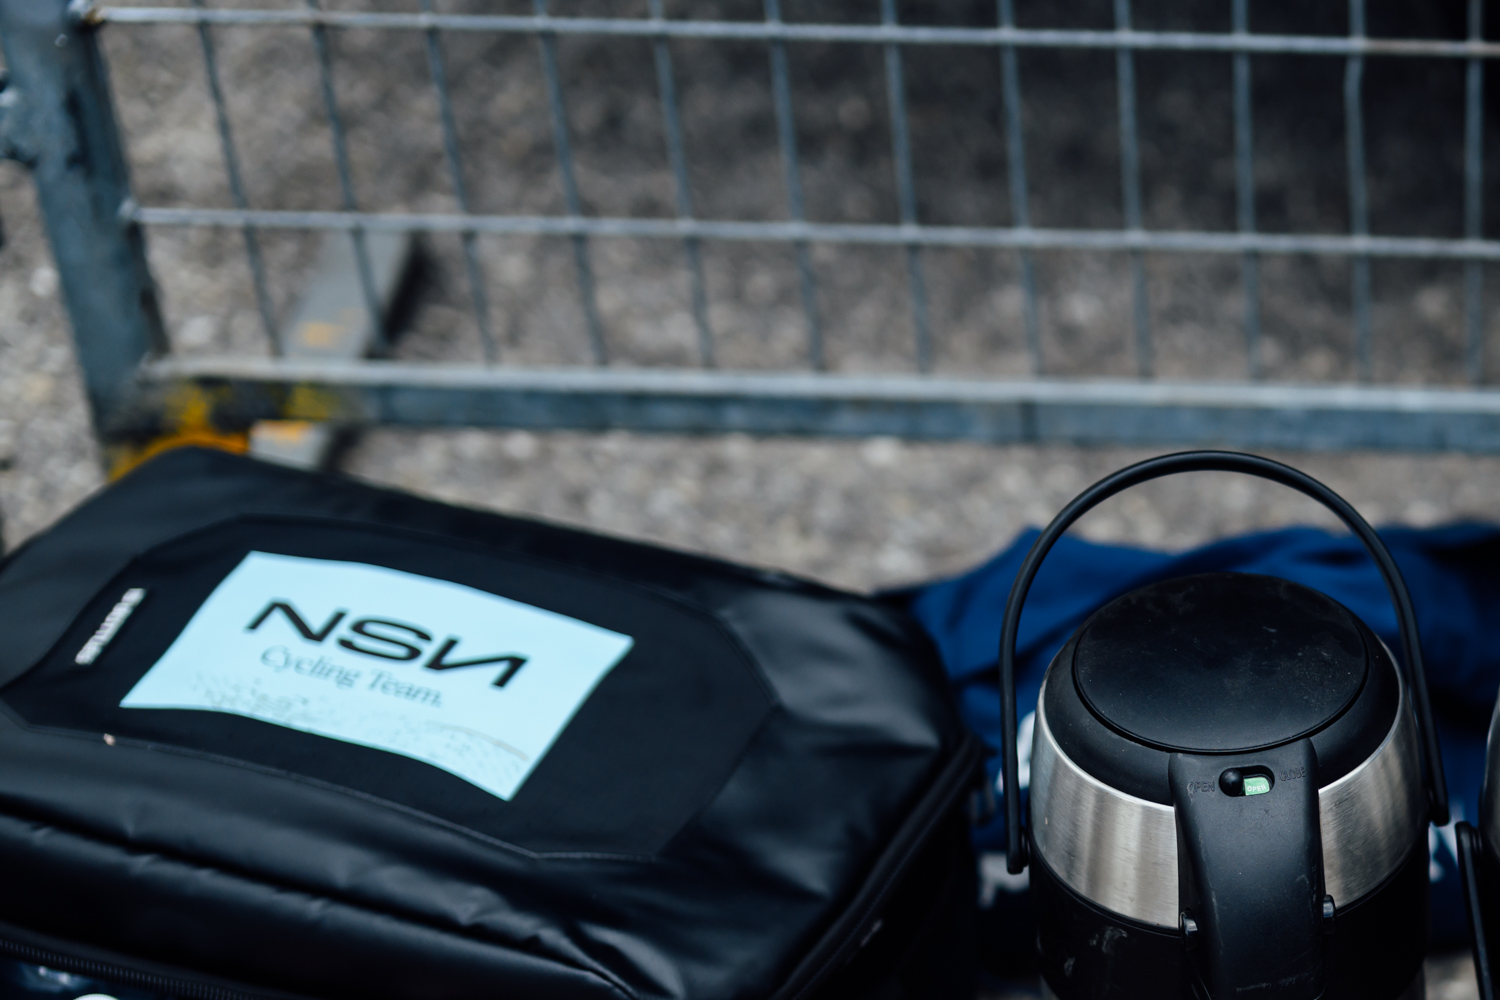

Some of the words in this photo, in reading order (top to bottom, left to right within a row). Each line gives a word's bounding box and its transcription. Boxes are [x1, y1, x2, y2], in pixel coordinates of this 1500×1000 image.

[259, 645, 358, 689] Cycling
[367, 668, 442, 708] Team
[1246, 784, 1267, 793] OPEN
